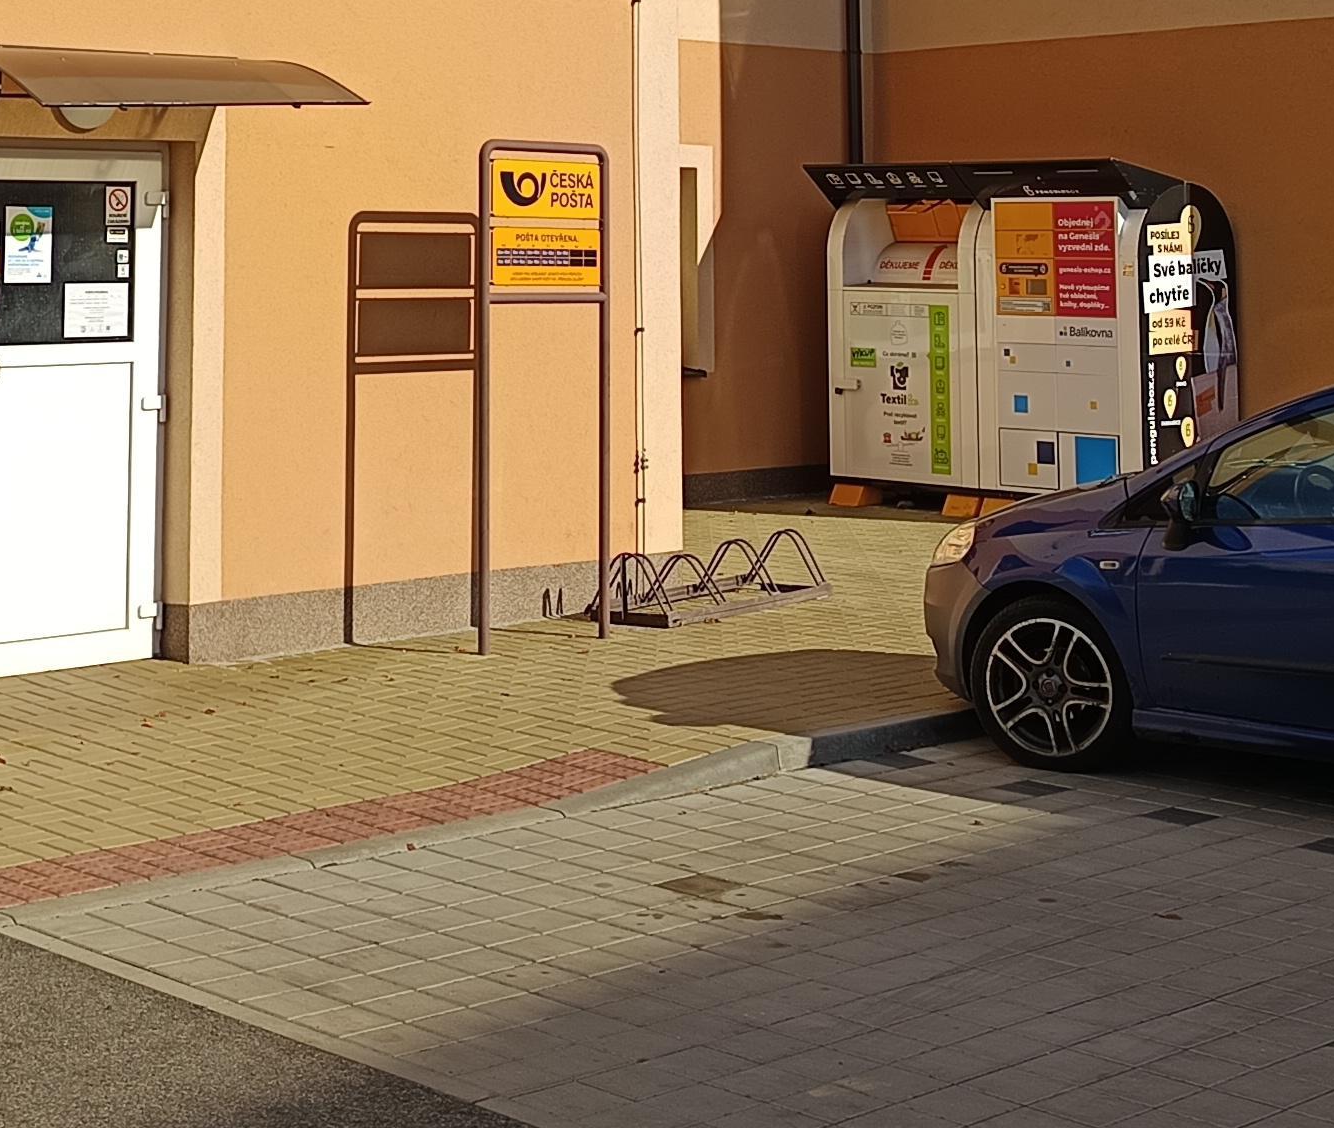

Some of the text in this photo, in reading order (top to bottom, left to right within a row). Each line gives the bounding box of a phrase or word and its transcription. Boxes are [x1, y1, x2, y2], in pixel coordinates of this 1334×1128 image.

[550, 170, 594, 189] ČESKÁ
[550, 190, 594, 208] POŠTA
[1058, 218, 1094, 228] Objednej
[515, 232, 539, 242] POŠTA
[1068, 232, 1100, 240] Genesis
[1150, 229, 1179, 240] POSÍLEJ
[1058, 243, 1093, 252] vyzvedni
[1157, 242, 1183, 253] S NÁMI
[1153, 257, 1222, 278] Své balíčky
[1149, 285, 1190, 306] chytře
[1152, 319, 1163, 328] od
[1175, 317, 1186, 327] Kč
[1069, 326, 1113, 338] Balíkovna
[1152, 332, 1194, 348] po celé ČR
[880, 393, 907, 405] Textil
[1147, 362, 1159, 465] penguinbox.cz
